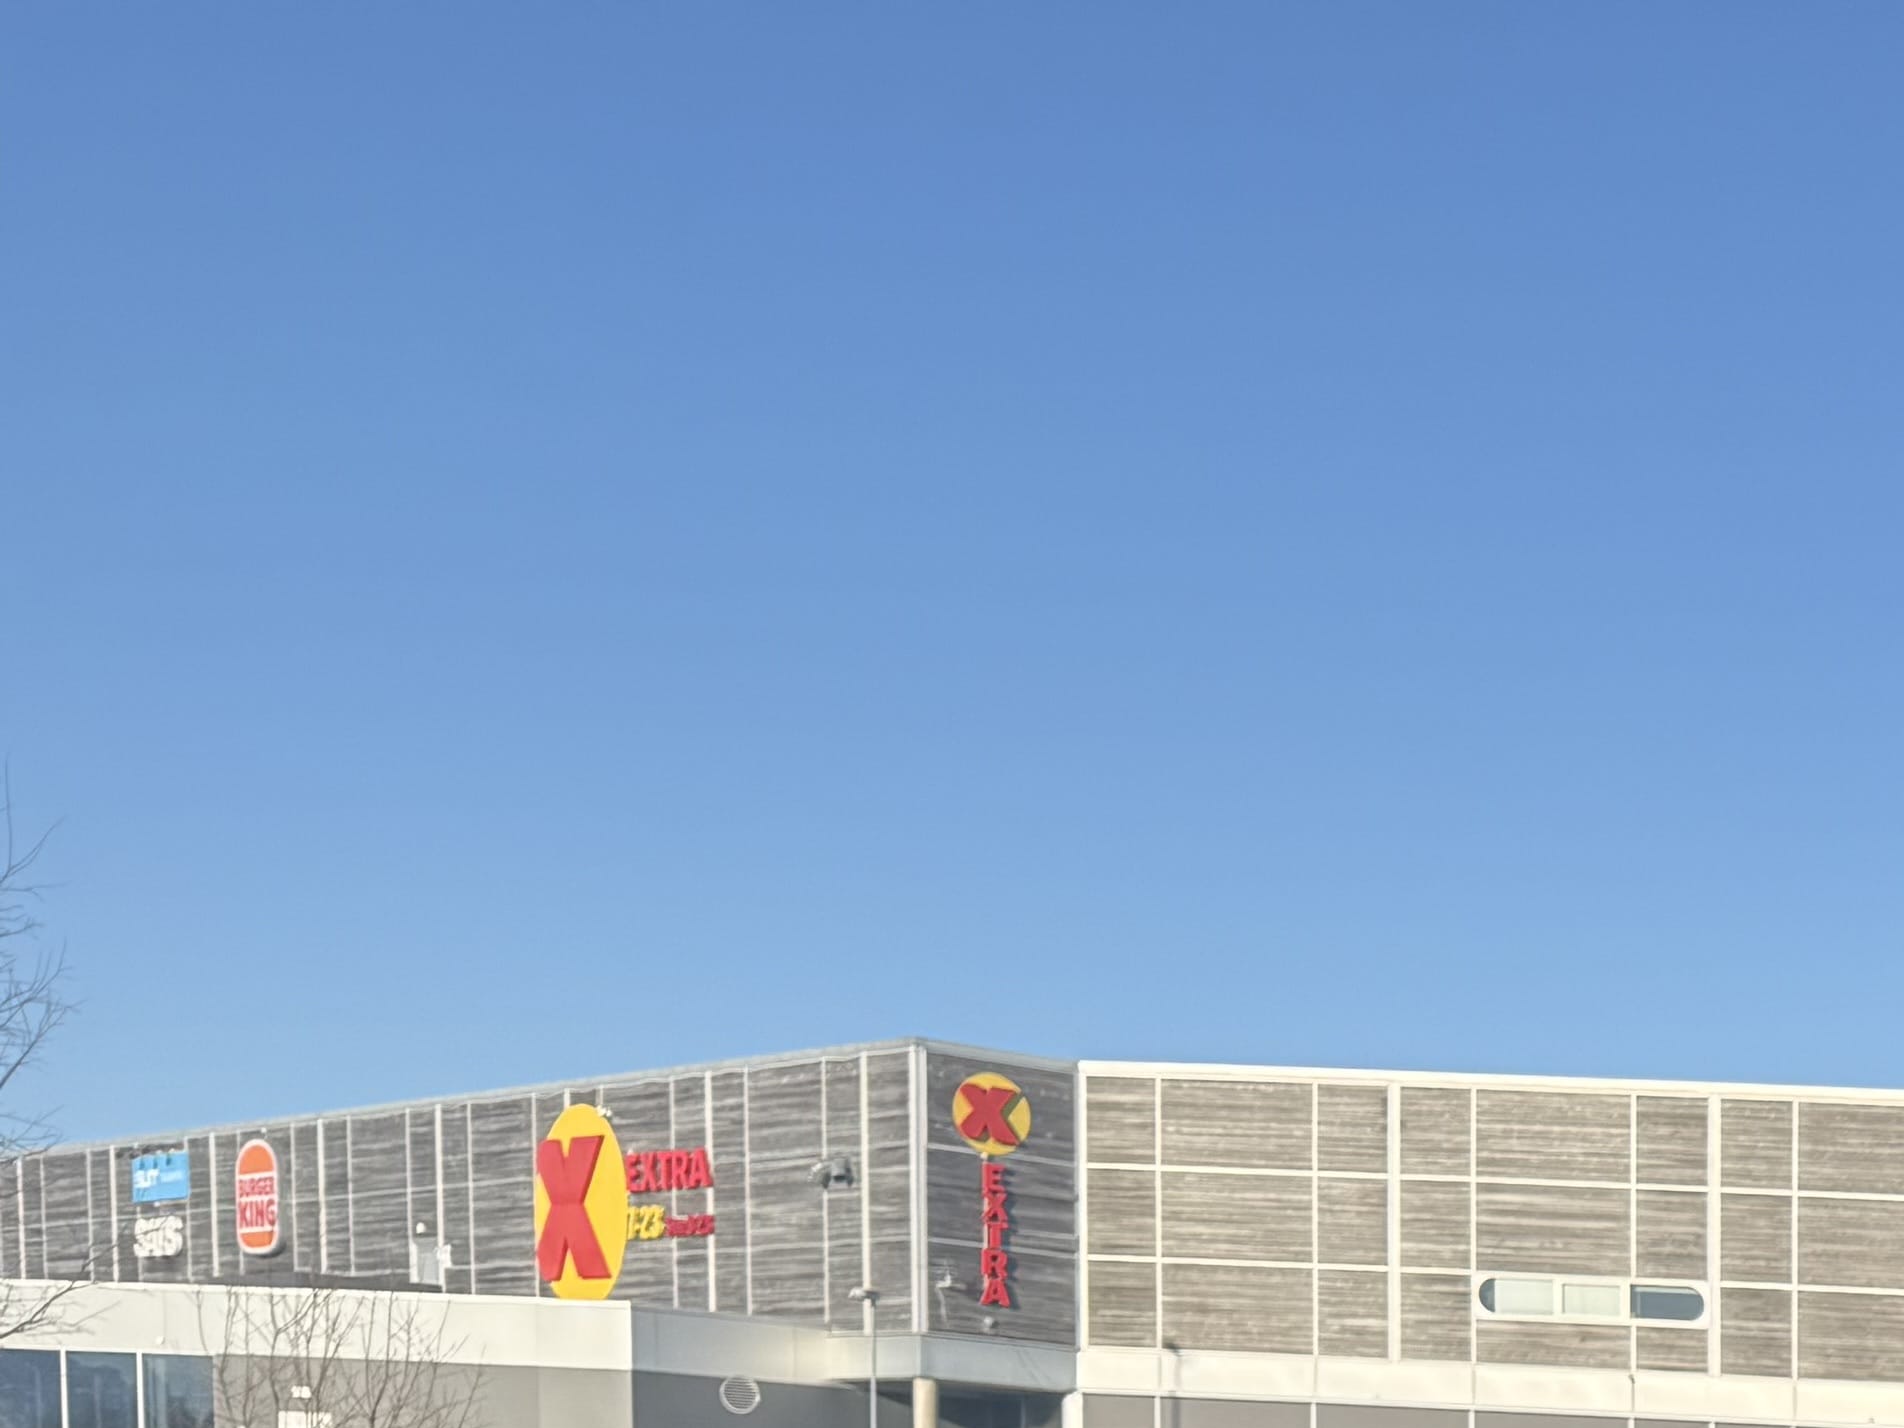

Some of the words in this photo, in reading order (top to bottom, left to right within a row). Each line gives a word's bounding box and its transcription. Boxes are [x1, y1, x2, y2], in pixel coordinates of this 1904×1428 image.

[238, 1176, 275, 1197] BURGER
[625, 1147, 714, 1194] EXTRA
[238, 1199, 277, 1229] KING
[980, 1162, 1010, 1308] EXTRA
